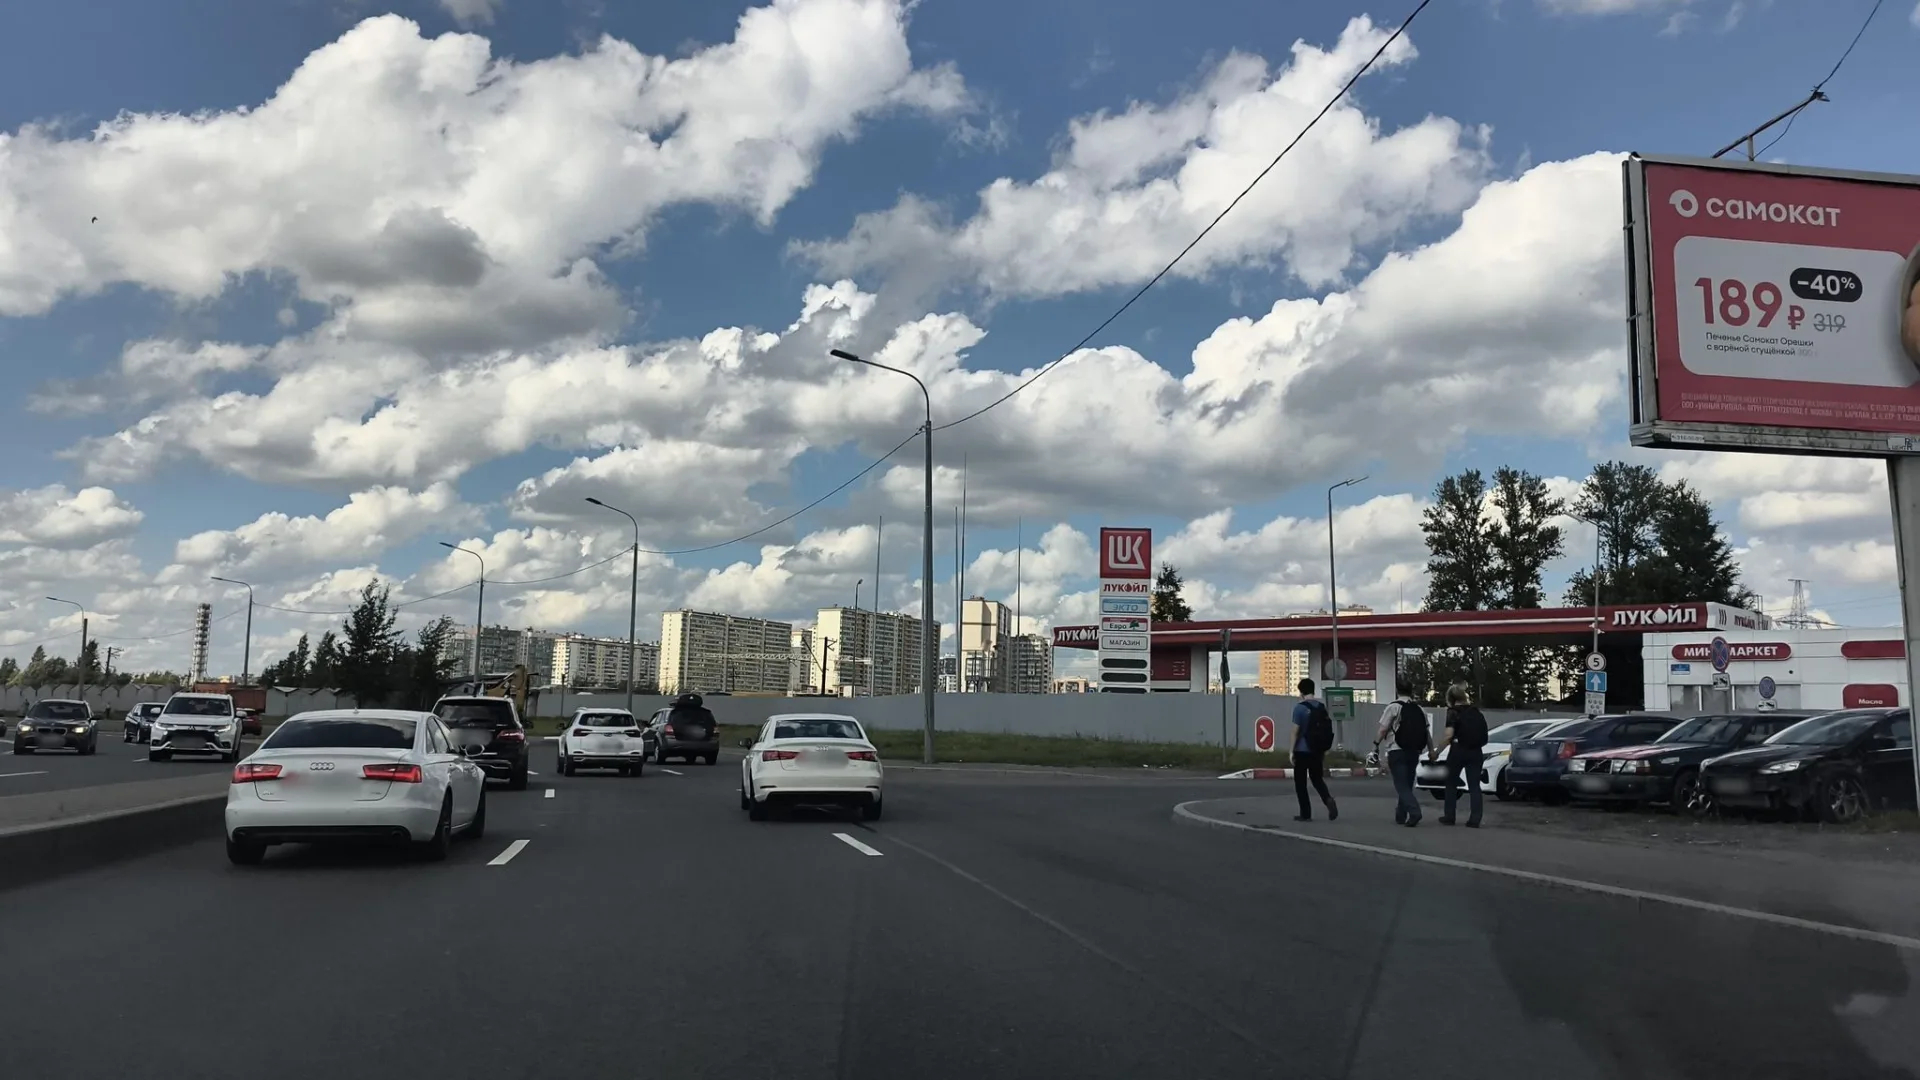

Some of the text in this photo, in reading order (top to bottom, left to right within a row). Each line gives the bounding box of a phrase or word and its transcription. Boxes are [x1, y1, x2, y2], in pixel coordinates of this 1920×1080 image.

[1706, 197, 1841, 227] самокат
[1813, 312, 1846, 333] 319
[1706, 332, 1814, 347] Печенье Самокат Орешки
[1714, 344, 1750, 353] варёной
[1751, 346, 1796, 356] сгущёнкой
[1109, 535, 1146, 570] LUK
[1593, 657, 1600, 668] 5
